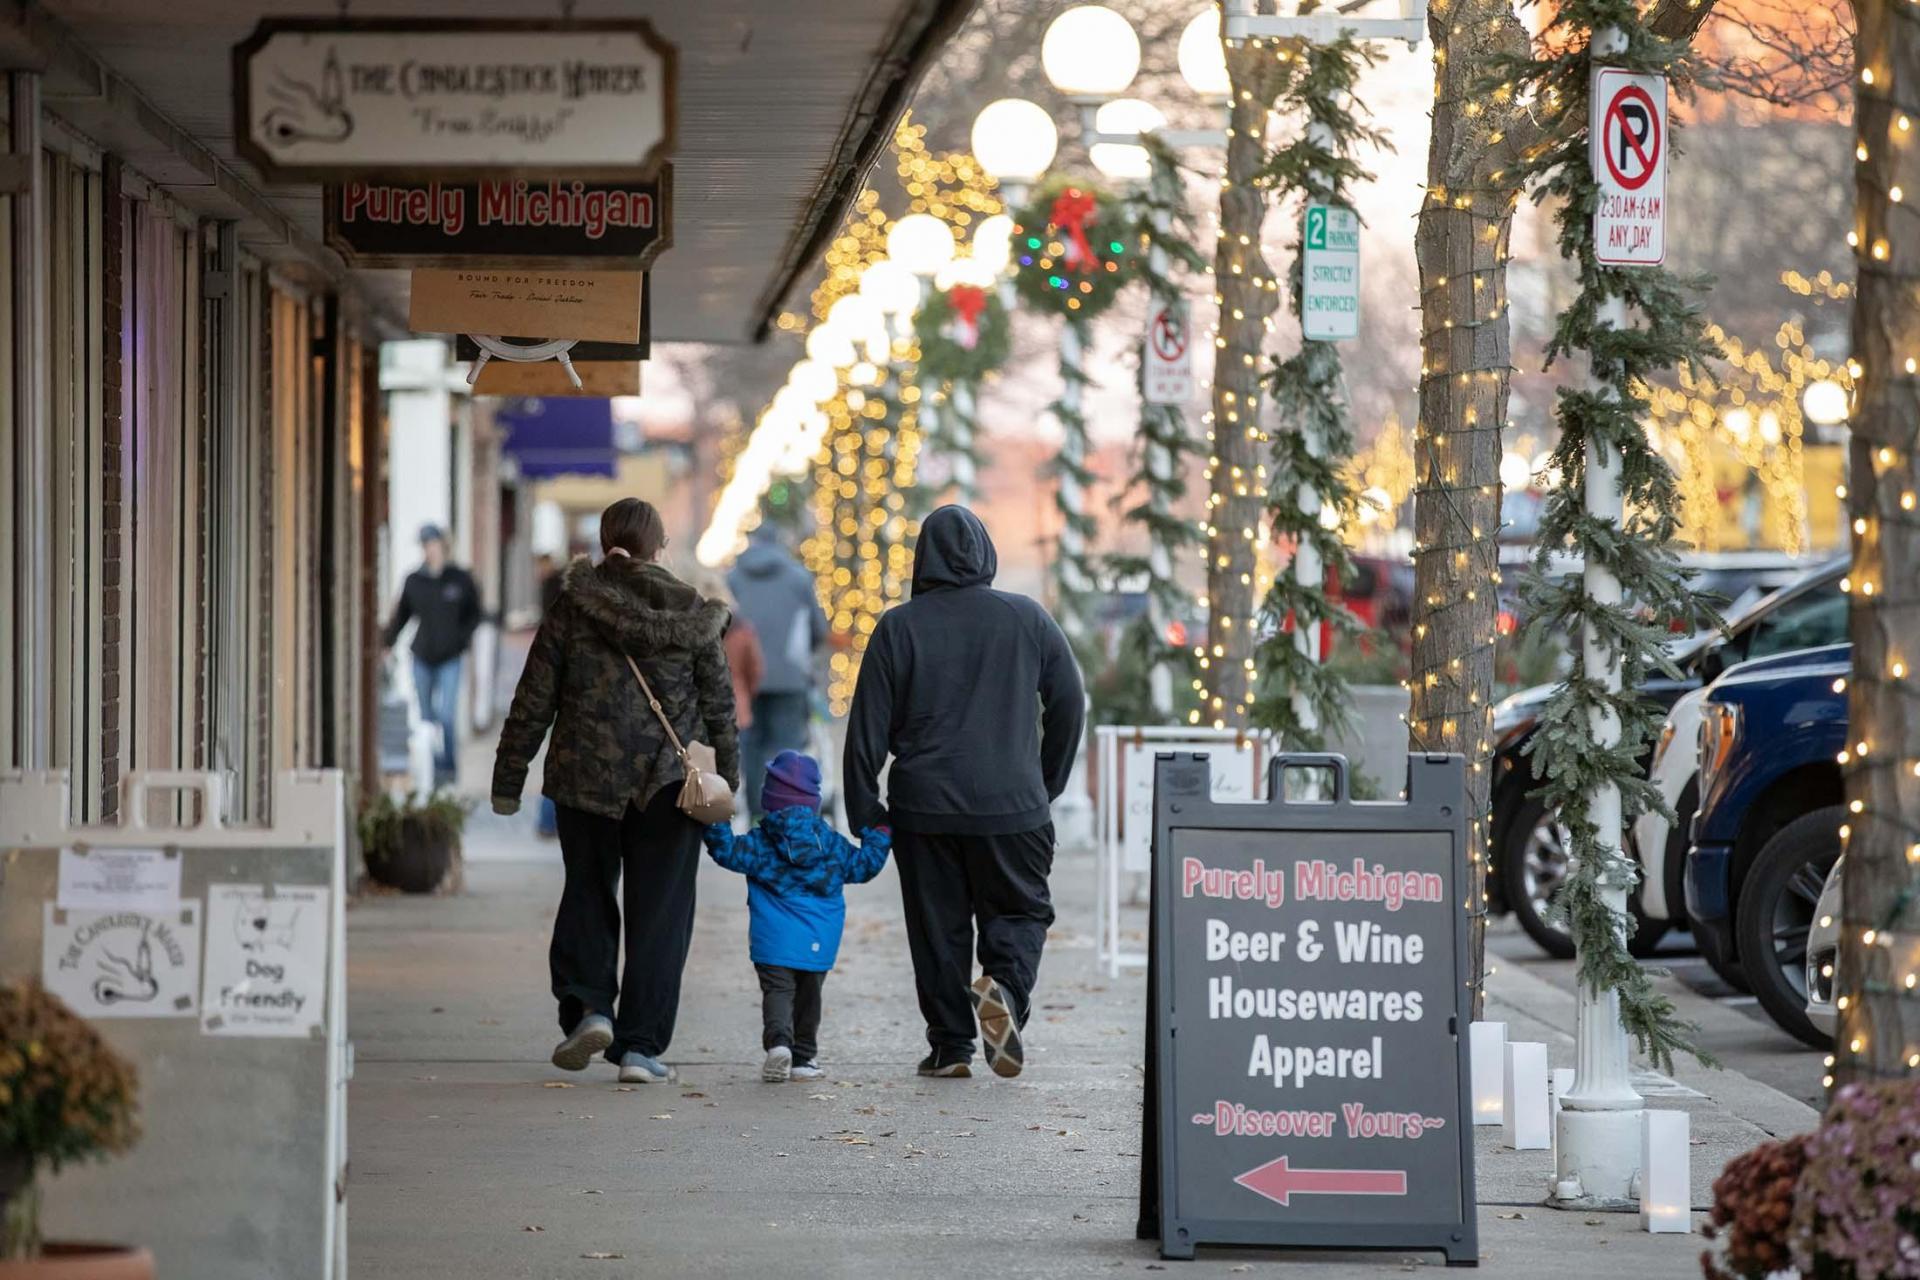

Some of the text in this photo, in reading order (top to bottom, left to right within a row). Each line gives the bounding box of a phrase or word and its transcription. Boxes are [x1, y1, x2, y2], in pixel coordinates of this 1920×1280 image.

[351, 65, 395, 95] THE
[343, 178, 653, 238] Purely Michigan
[1310, 211, 1324, 245] 2
[1608, 225, 1652, 249] ANY DAY
[458, 274, 595, 287] BOUND FOR FREEDOM
[1312, 265, 1353, 282] STRICTLY
[1308, 295, 1357, 313] ENFORCED
[1182, 857, 1443, 911] Purely Michigan
[1206, 919, 1424, 965] Beer & Wine
[245, 959, 285, 984] Dog
[220, 985, 306, 1014] Friendly
[1208, 976, 1423, 1022] Housewares
[1248, 1034, 1382, 1089] Apparel
